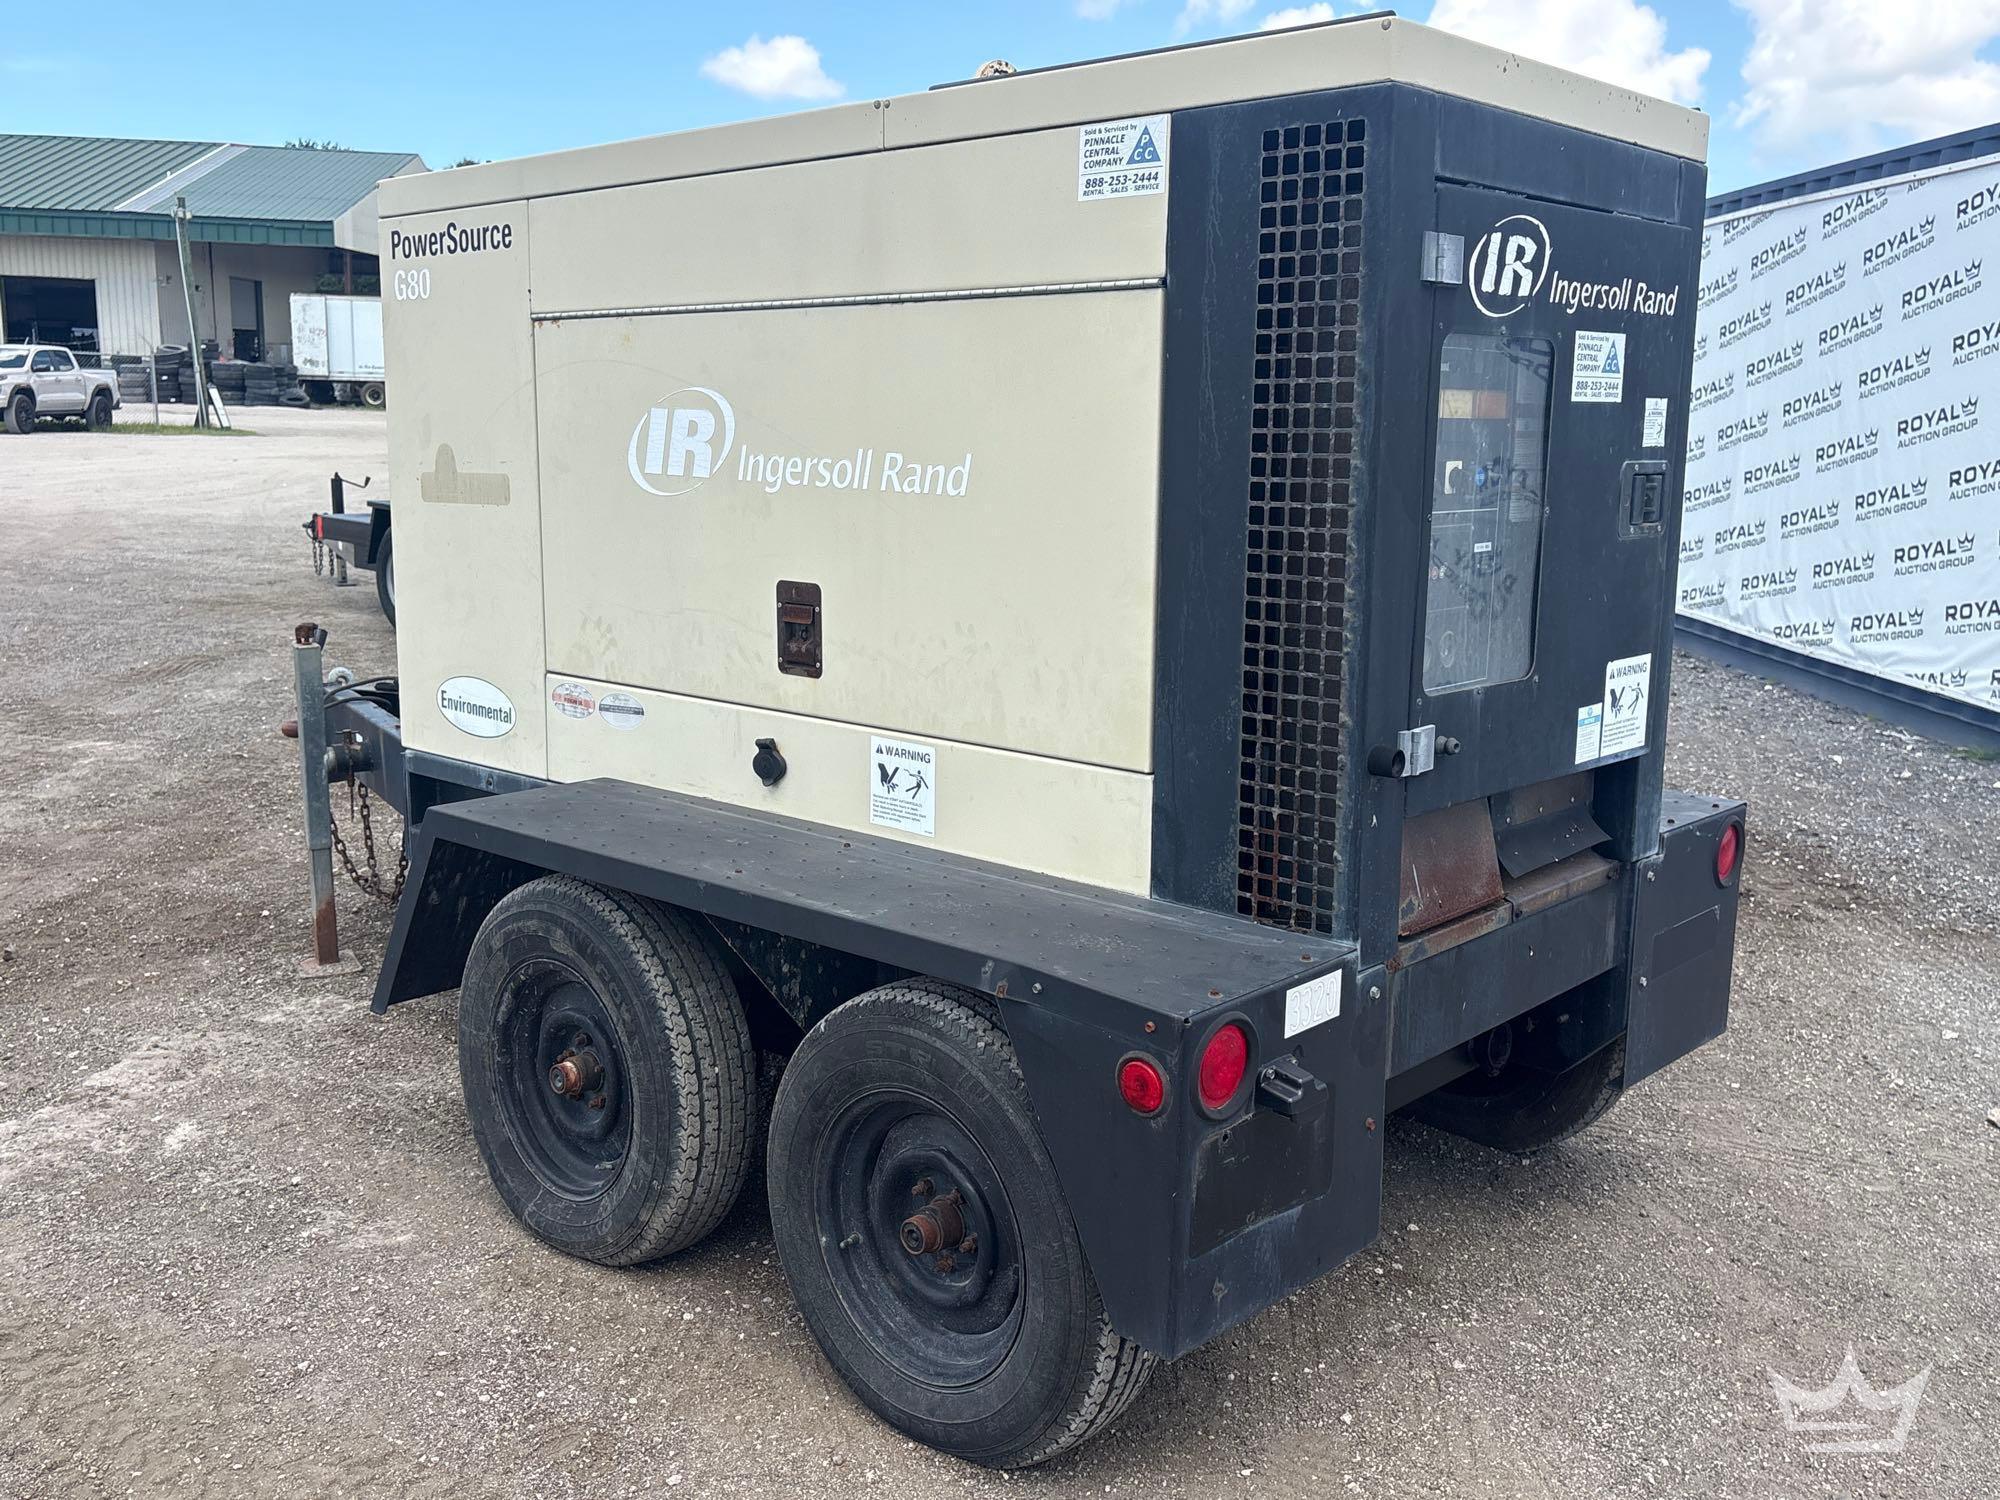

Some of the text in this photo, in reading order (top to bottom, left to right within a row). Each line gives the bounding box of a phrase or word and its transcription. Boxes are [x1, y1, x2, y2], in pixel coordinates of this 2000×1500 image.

[1084, 134, 1125, 147] PINNACLE
[1085, 128, 1096, 136] Sold
[1104, 125, 1128, 133] Serviced
[1141, 135, 1149, 146] P
[1084, 146, 1120, 158] CENTRAL
[1084, 157, 1124, 169] COMPANY
[1083, 187, 1104, 197] RENTAL
[1110, 186, 1128, 194] SALES
[1134, 183, 1160, 191] SERVICE
[1085, 171, 1159, 188] 888-253-2444
[1822, 190, 1873, 229] ROYAL
[1822, 198, 1888, 241] AUCTION GROUP
[391, 222, 512, 259] PowerSource
[1864, 226, 1918, 266] ROYAL
[1481, 232, 1537, 297] IR
[1751, 236, 1794, 271] ROYAL
[1751, 244, 1806, 281] AUCTION GROUP
[1863, 236, 1935, 278] AUCTION GROUP
[394, 269, 430, 300] G80
[1549, 271, 1678, 316] Ingersoll Rand
[1698, 276, 1727, 300] OYAL
[1786, 271, 1832, 306] ROYAL
[1902, 270, 1964, 309] ROYAL
[1786, 281, 1846, 317] AUCTION GROUP
[1901, 280, 1981, 322] AUCTION GROUP
[1719, 309, 1760, 339] ROYAL
[1818, 312, 1868, 346] ROYAL
[1578, 343, 1602, 351] PINNACLE
[1818, 323, 1882, 358] AUCTION GROUP
[1577, 353, 1598, 362] CENTRAL
[1746, 348, 1791, 378] ROYAL
[1952, 342, 1999, 367] AUCTION
[1576, 364, 1600, 372] COMPANY
[1746, 358, 1803, 388] AUCTION GROUP
[1859, 355, 1914, 388] ROYAL
[1576, 381, 1619, 391] 888-253-2444
[1712, 388, 1734, 404] GROUP
[1858, 367, 1930, 400] AUCTION GROUP
[1782, 388, 1830, 417] ROYAL
[1782, 400, 1842, 428] AUCTION GROUP
[1718, 416, 1757, 442] ROYAL
[1897, 404, 1960, 437] ROYAL
[644, 407, 716, 478] IR
[1742, 427, 1768, 442] GROUP
[1897, 418, 1978, 449] AUCTION GROUP
[1816, 435, 1864, 463] ROYAL
[1816, 447, 1878, 474] AUCTION GROUP
[738, 445, 973, 497] Ingersoll Rand
[1744, 459, 1788, 484] ROYAL
[1744, 472, 1800, 495] AUCTION GROUP
[1949, 459, 2000, 488] ROYA
[1684, 481, 1722, 503] ROYAL
[1855, 484, 1910, 510] ROYAL
[1949, 482, 1996, 501] AUCTION
[1780, 505, 1826, 529] ROYAL
[1855, 498, 1927, 522] AUCTION GROUP
[1714, 523, 1754, 545] ROYAL
[1780, 519, 1840, 540] AUCTION GROUP
[1894, 539, 1956, 564] ROYAL
[1812, 555, 1860, 579] ROYAL
[1894, 555, 1974, 576] AUCTION GROUP
[1682, 582, 1716, 602] ROYAL
[1741, 570, 1785, 591] ROYAL
[1812, 572, 1874, 590] AUCTION GROUP
[1851, 612, 1907, 632] ROYAL
[1945, 600, 2000, 622] ROYA
[1773, 622, 1820, 639] ROYAL
[1850, 629, 1923, 643] AUCTION GROUP
[1944, 623, 1992, 635] AUCTION
[1616, 662, 1647, 678] WARNING
[441, 690, 512, 725] Environmental
[885, 745, 931, 764] WARNING
[1289, 977, 1336, 1032] 3320
